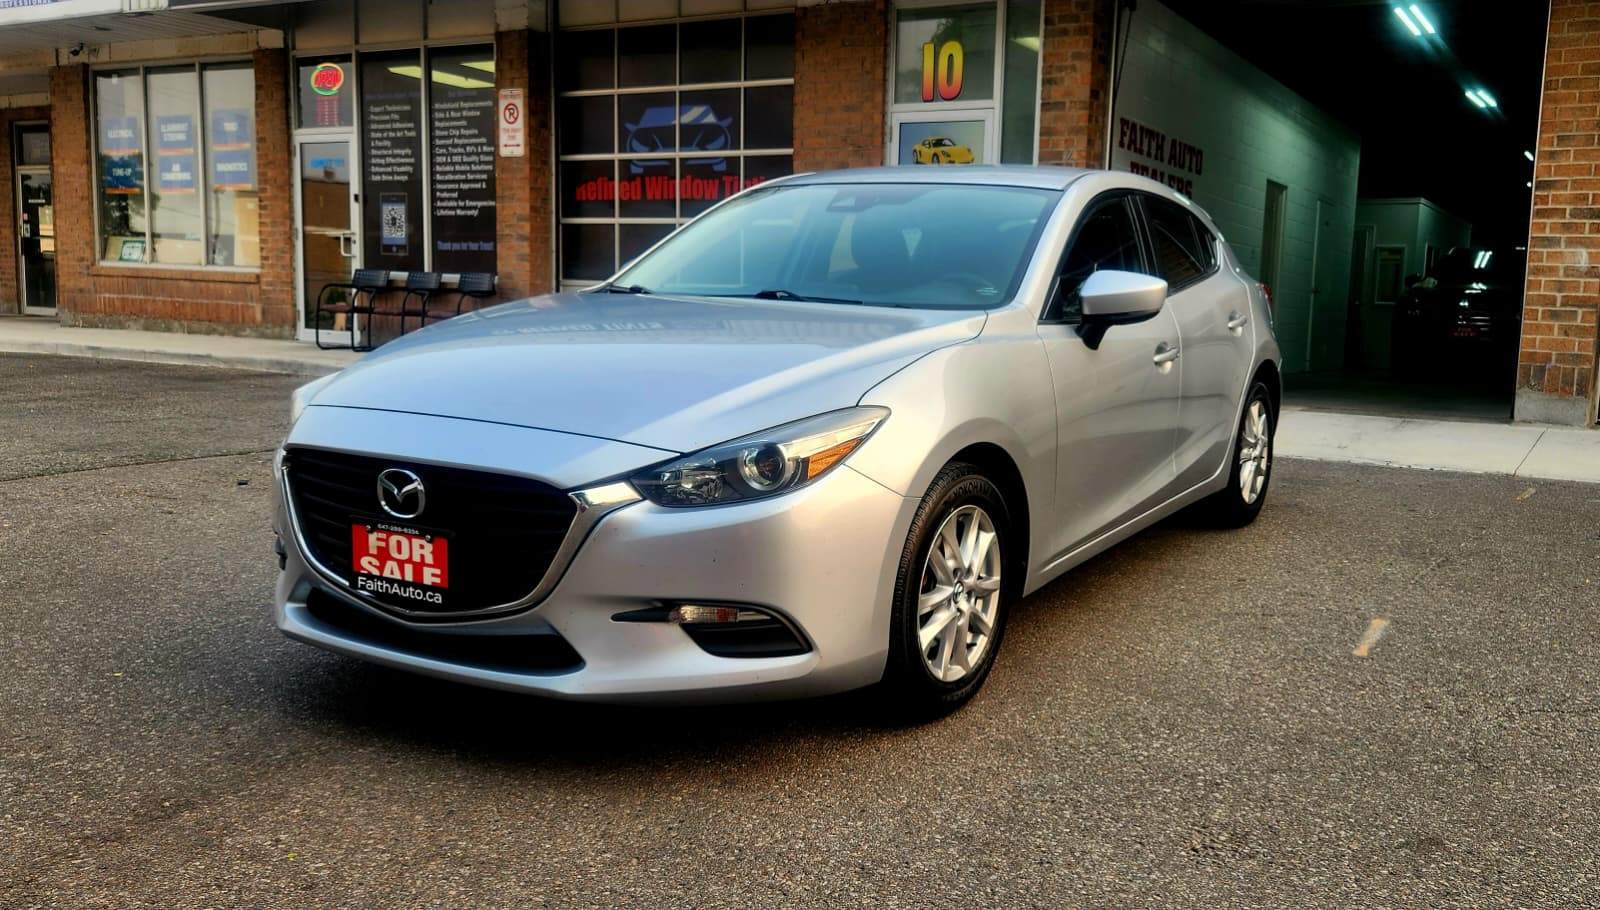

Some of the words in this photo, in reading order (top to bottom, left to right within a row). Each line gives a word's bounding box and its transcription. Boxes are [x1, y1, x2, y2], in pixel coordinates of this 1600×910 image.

[921, 40, 964, 103] 10
[1119, 117, 1166, 162] FAITH
[1168, 138, 1203, 176] AUTO
[644, 173, 720, 201] Window
[367, 531, 434, 565] FOR
[357, 576, 443, 604] FaithAuto.ca
